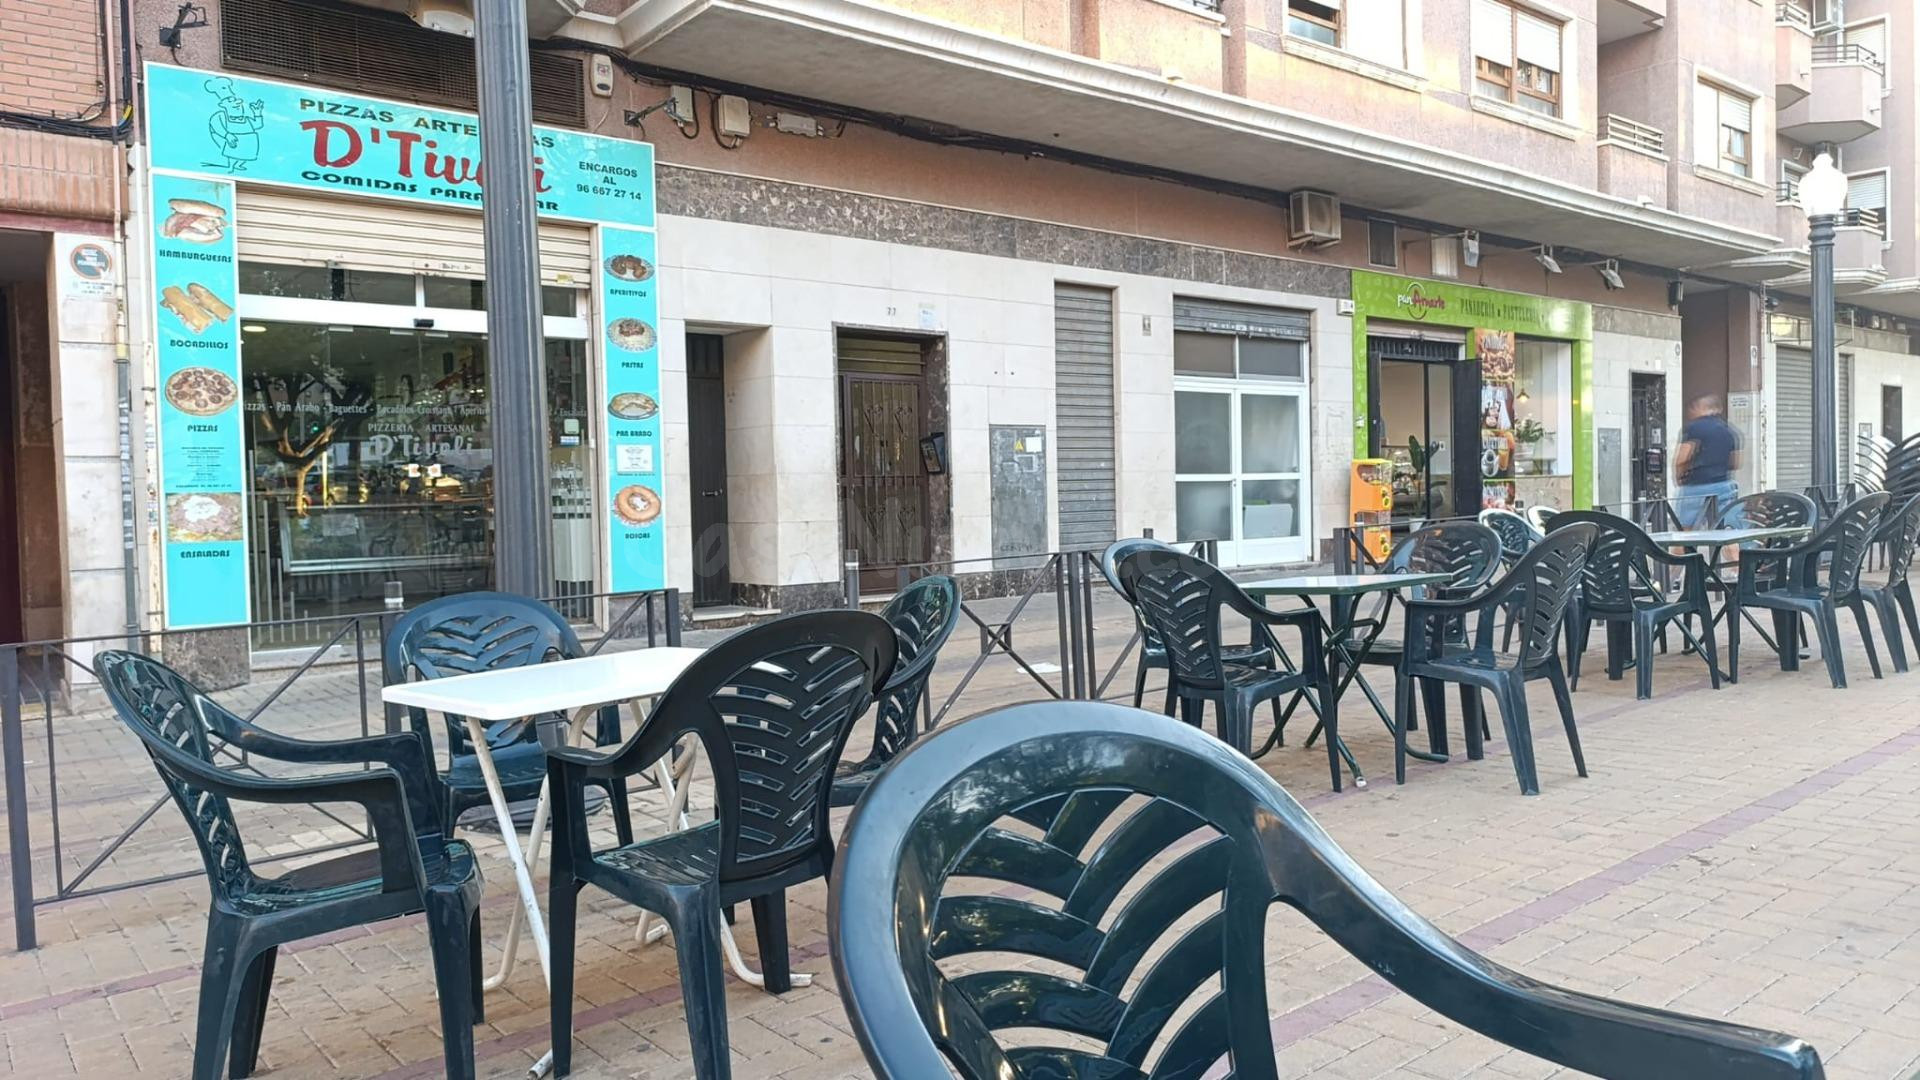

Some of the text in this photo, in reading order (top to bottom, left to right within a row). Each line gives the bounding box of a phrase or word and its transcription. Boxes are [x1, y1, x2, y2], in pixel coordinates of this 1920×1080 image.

[300, 98, 394, 123] PIZZAS
[300, 120, 552, 193] D'Tivi
[579, 161, 638, 178] ENCARGOS
[301, 171, 417, 193] COMIDAS
[603, 175, 617, 186] AL
[576, 184, 642, 200] 96 667 27 14
[159, 249, 232, 263] HAMBURGUESAS
[610, 288, 647, 298] APERITIVOS
[170, 339, 229, 350] BOCADILLOS
[621, 361, 644, 369] PASTAS
[187, 424, 218, 433] PIZZAS
[367, 422, 475, 434] PIZZERIA ARTESANAL
[180, 549, 230, 559] ENSALADAS
